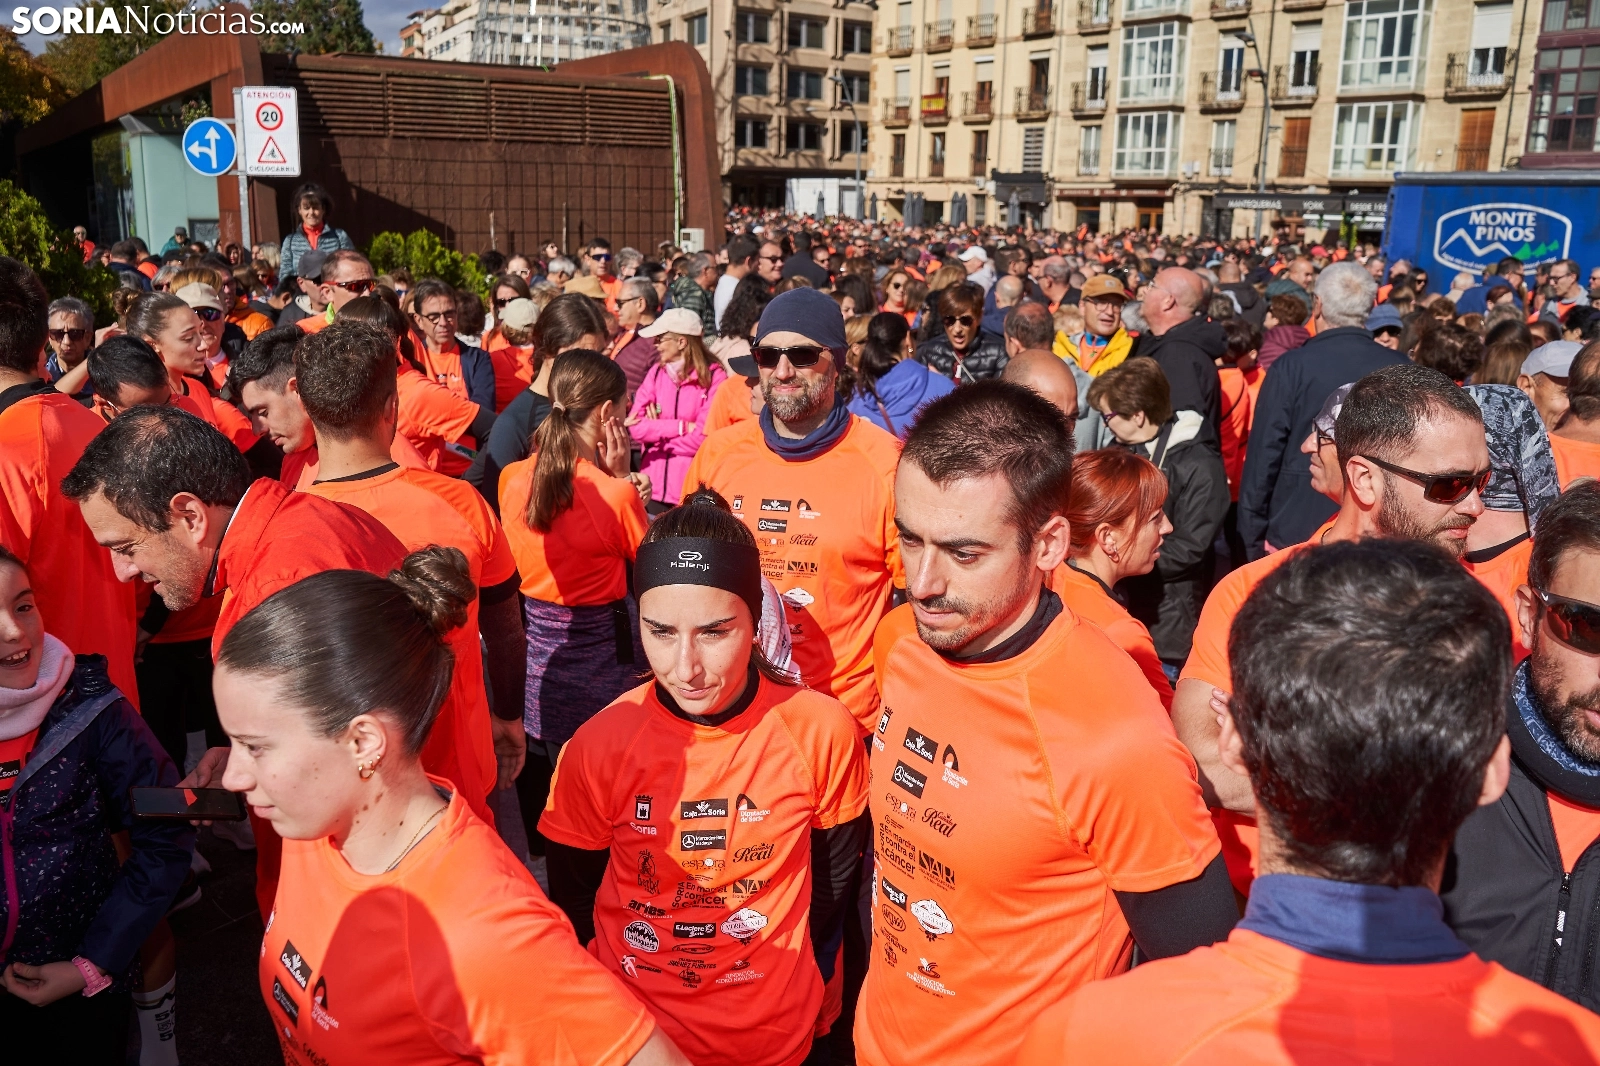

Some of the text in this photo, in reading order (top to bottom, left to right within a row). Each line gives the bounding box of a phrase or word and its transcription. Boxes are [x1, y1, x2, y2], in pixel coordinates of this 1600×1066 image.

[246, 91, 292, 99] ATENCIÓN
[261, 111, 278, 122] 20
[1468, 211, 1537, 227] MONTE
[1475, 226, 1535, 242] PINOS
[670, 560, 710, 571] Kalenji
[920, 747, 933, 761] Soria
[708, 808, 726, 816] Soria
[921, 807, 958, 838] Real
[885, 836, 916, 862] contra el
[892, 833, 916, 852] marcha
[732, 843, 775, 863] Real
[884, 847, 916, 875] cáncer
[686, 882, 696, 890] En
[672, 881, 685, 908] SORIA
